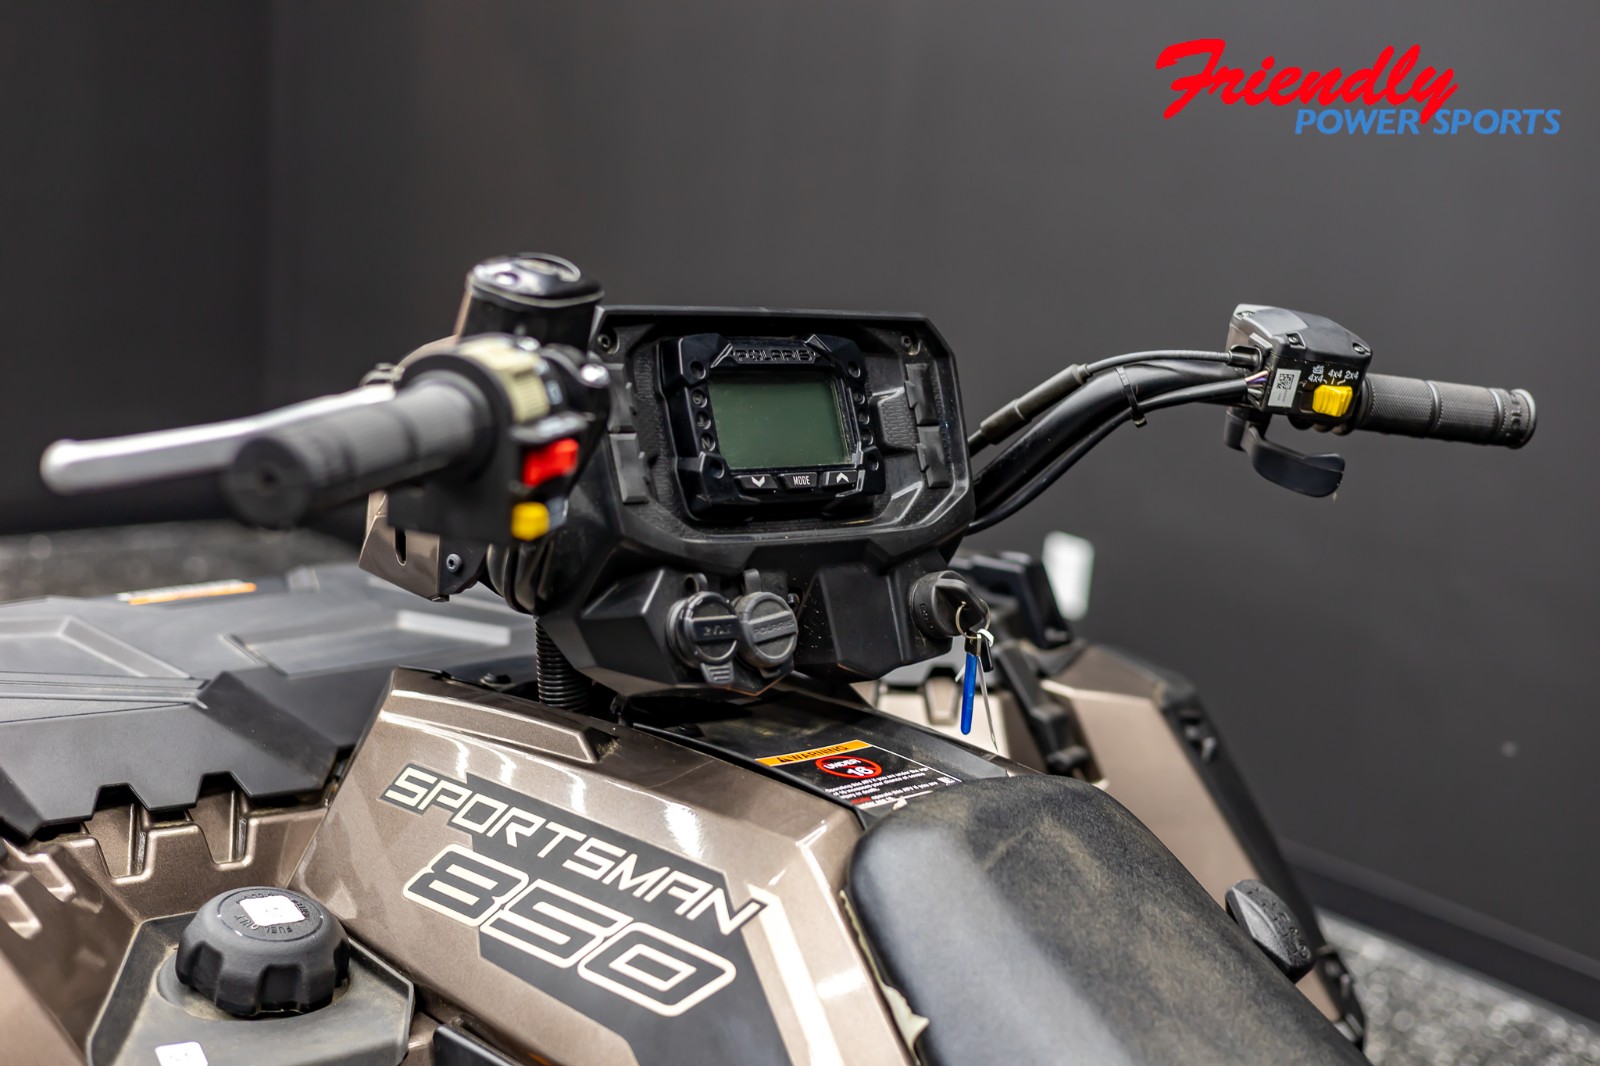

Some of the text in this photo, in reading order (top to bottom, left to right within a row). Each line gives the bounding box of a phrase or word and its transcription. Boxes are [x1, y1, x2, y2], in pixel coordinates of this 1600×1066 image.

[793, 475, 811, 486] MODE
[788, 745, 849, 760] WARNING
[824, 758, 862, 770] UNDER
[847, 766, 874, 776] 16
[384, 766, 767, 936] SPORTSMAN
[402, 843, 737, 1017] 850
